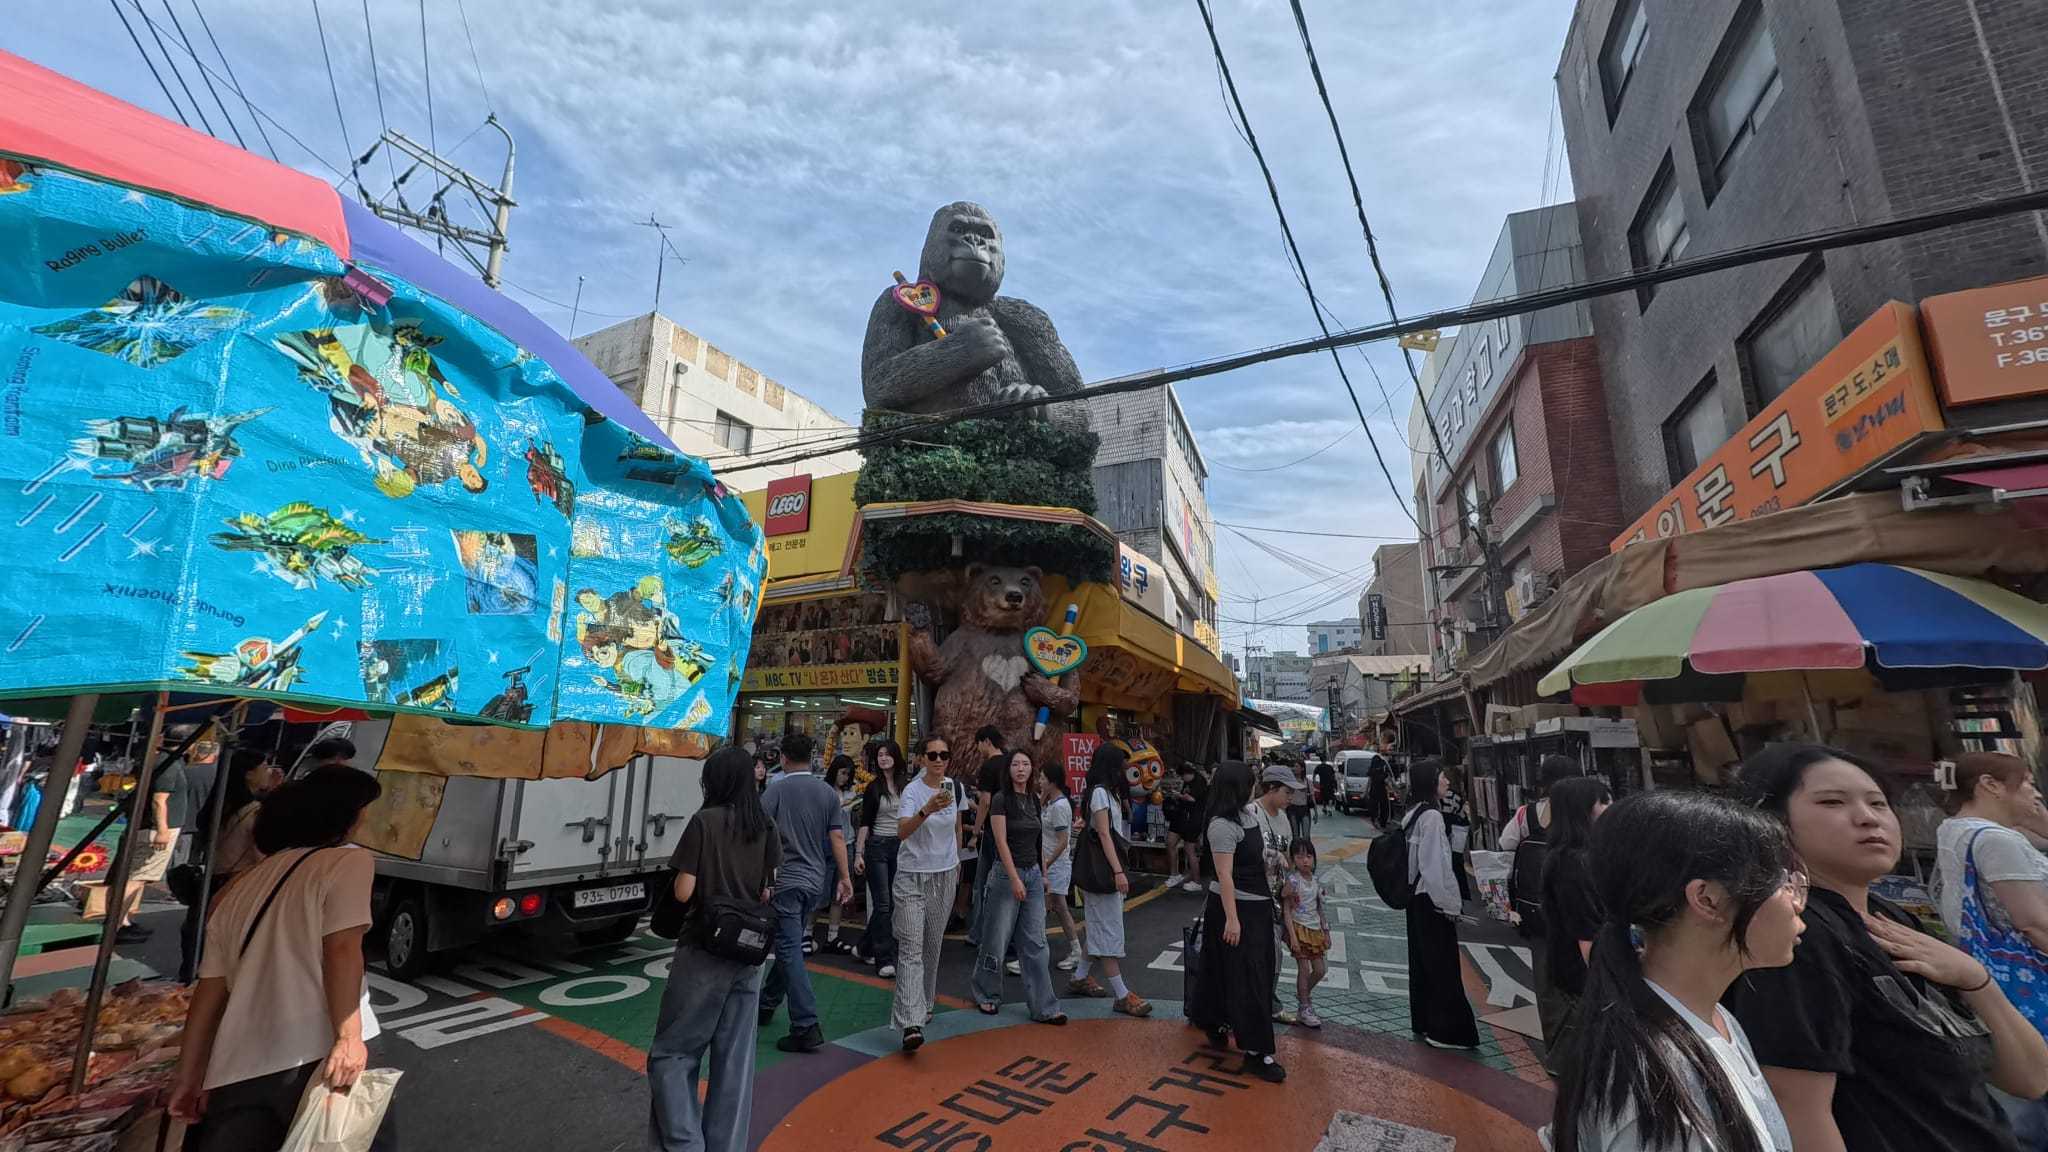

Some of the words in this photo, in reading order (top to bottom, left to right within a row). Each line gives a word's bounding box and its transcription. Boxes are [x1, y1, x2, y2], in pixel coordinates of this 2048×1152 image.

[45, 246, 101, 272] Raging
[99, 228, 149, 252] Bullet
[1984, 305, 2034, 328] 문구
[1824, 393, 1849, 418] 문구
[769, 491, 807, 518] LEGO
[785, 538, 806, 551] 전문점
[1121, 555, 1149, 594] 완구
[102, 583, 183, 606] Phoenix
[790, 672, 801, 687] TV
[866, 668, 887, 684] 방송
[1070, 738, 1095, 754] TAX
[609, 885, 639, 900] 0790
